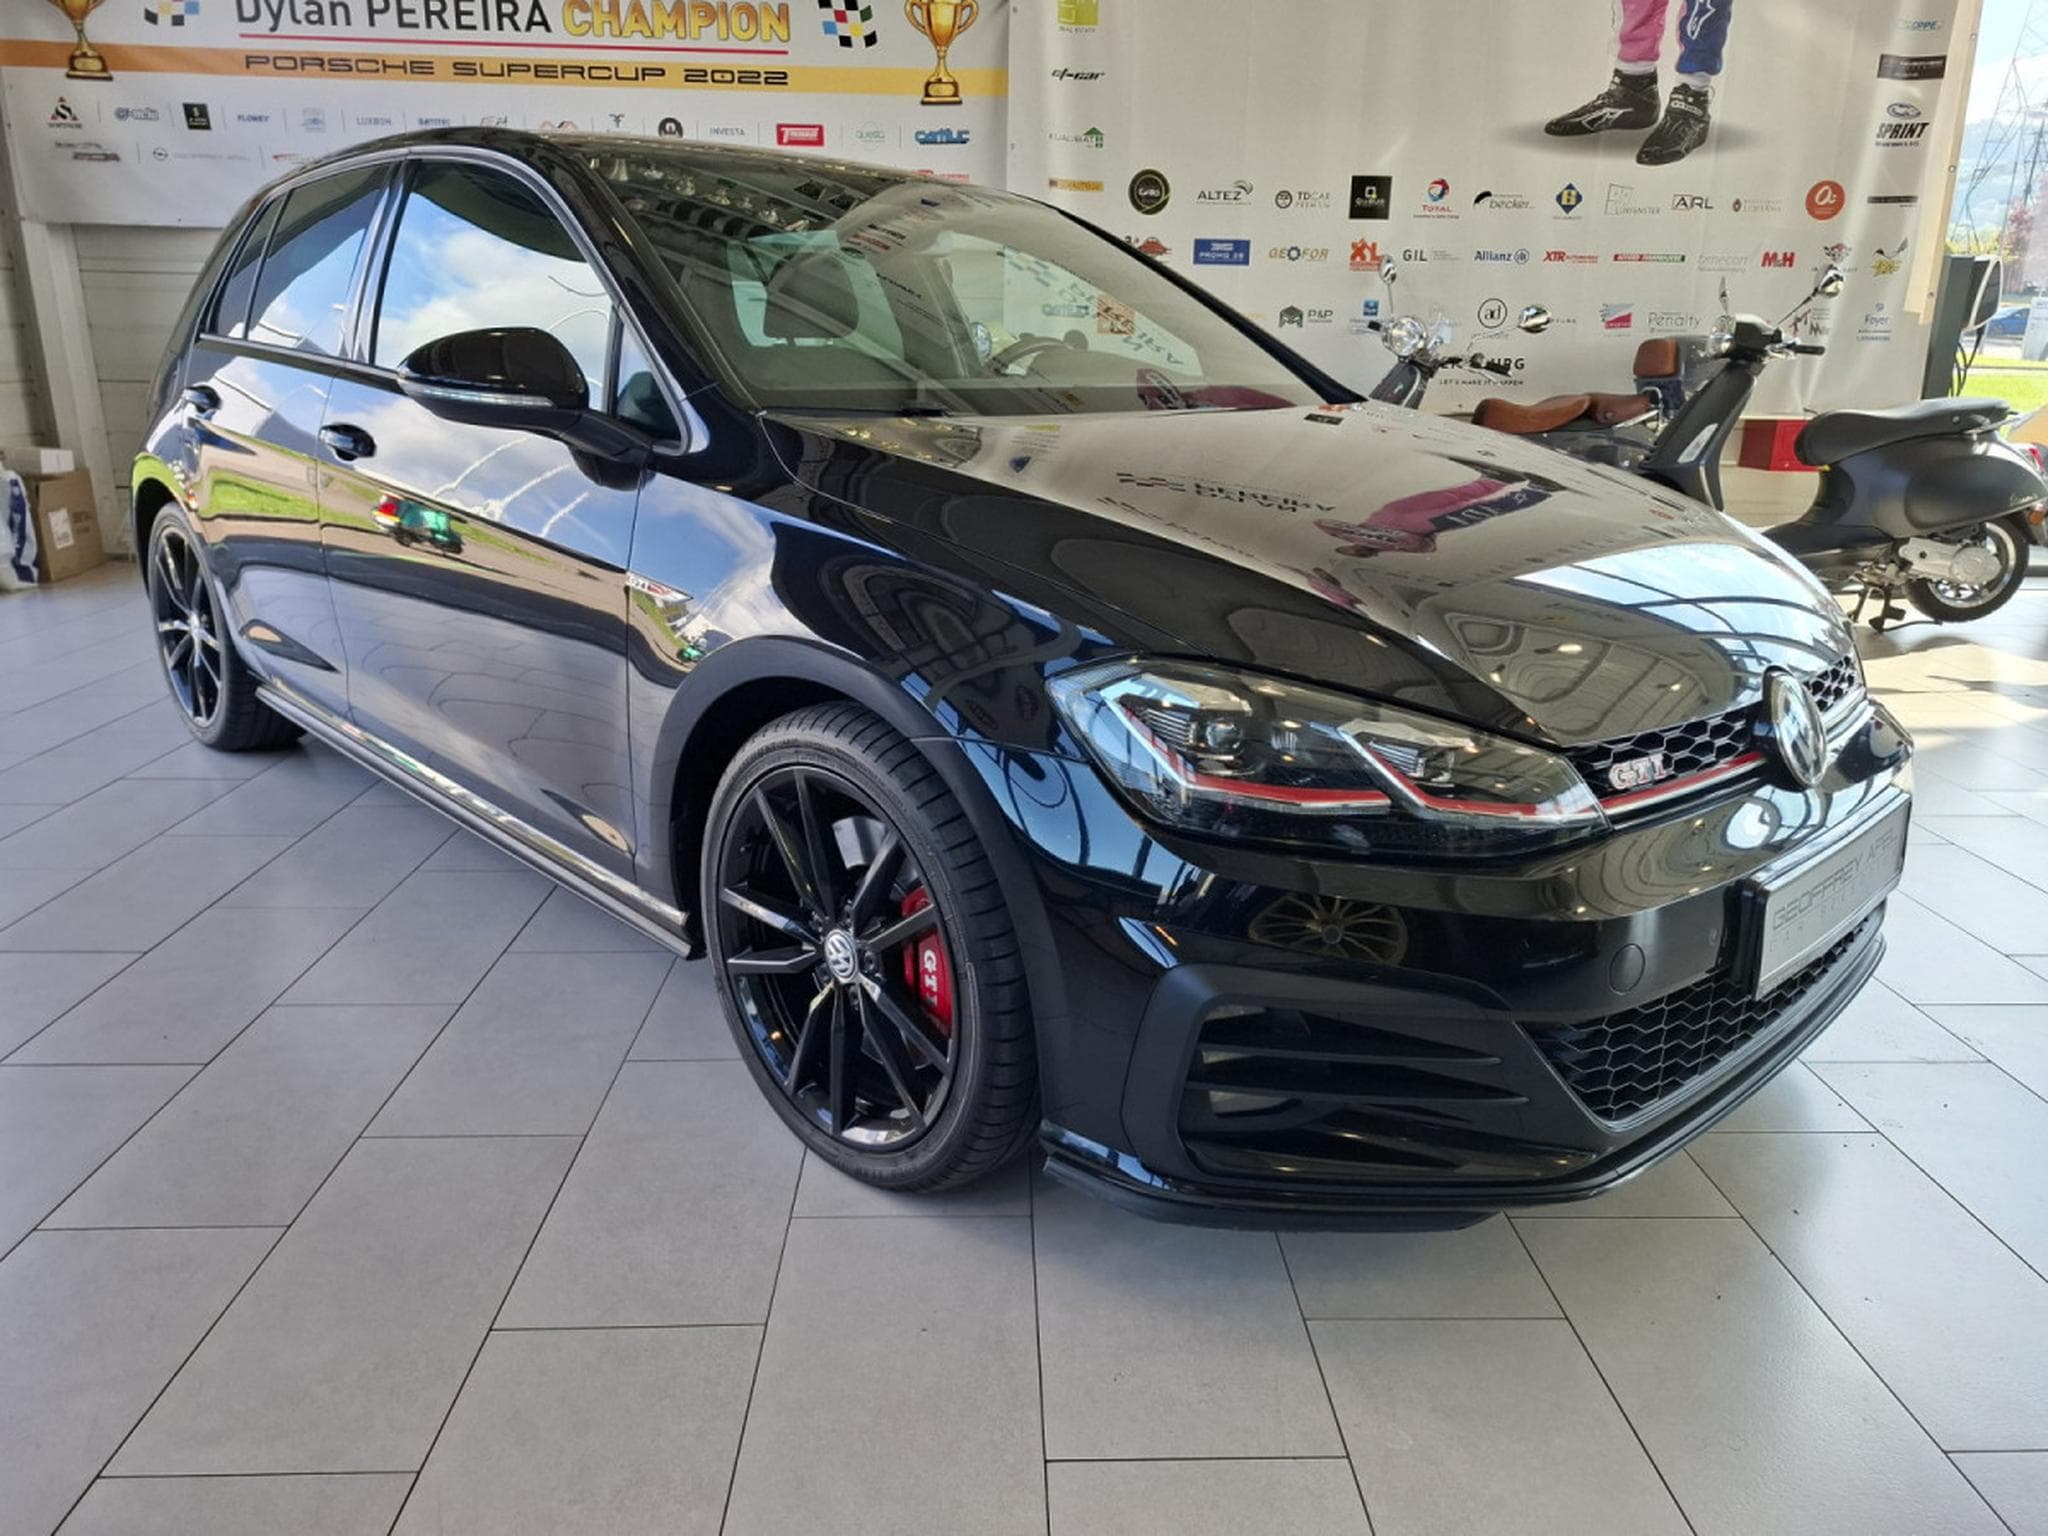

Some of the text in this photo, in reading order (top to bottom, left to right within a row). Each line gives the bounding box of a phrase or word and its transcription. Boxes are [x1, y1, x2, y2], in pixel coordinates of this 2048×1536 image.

[237, 0, 791, 42] Dylan PEREIRA CHAMPION
[245, 55, 789, 86] PORSCHE SUPERCUP 2022
[1876, 122, 1930, 140] SPRINT
[1197, 190, 1242, 201] ALTEZ
[1422, 204, 1453, 213] TOTAL
[1675, 196, 1714, 210] ARL
[1268, 246, 1329, 261] GEOFOR
[1402, 249, 1428, 262] GIL
[1474, 250, 1513, 262] Allianz
[1543, 251, 1567, 262] XTR
[1307, 309, 1334, 318] P&P
[1648, 311, 1703, 328] Penalty
[1608, 753, 1665, 790] GTI
